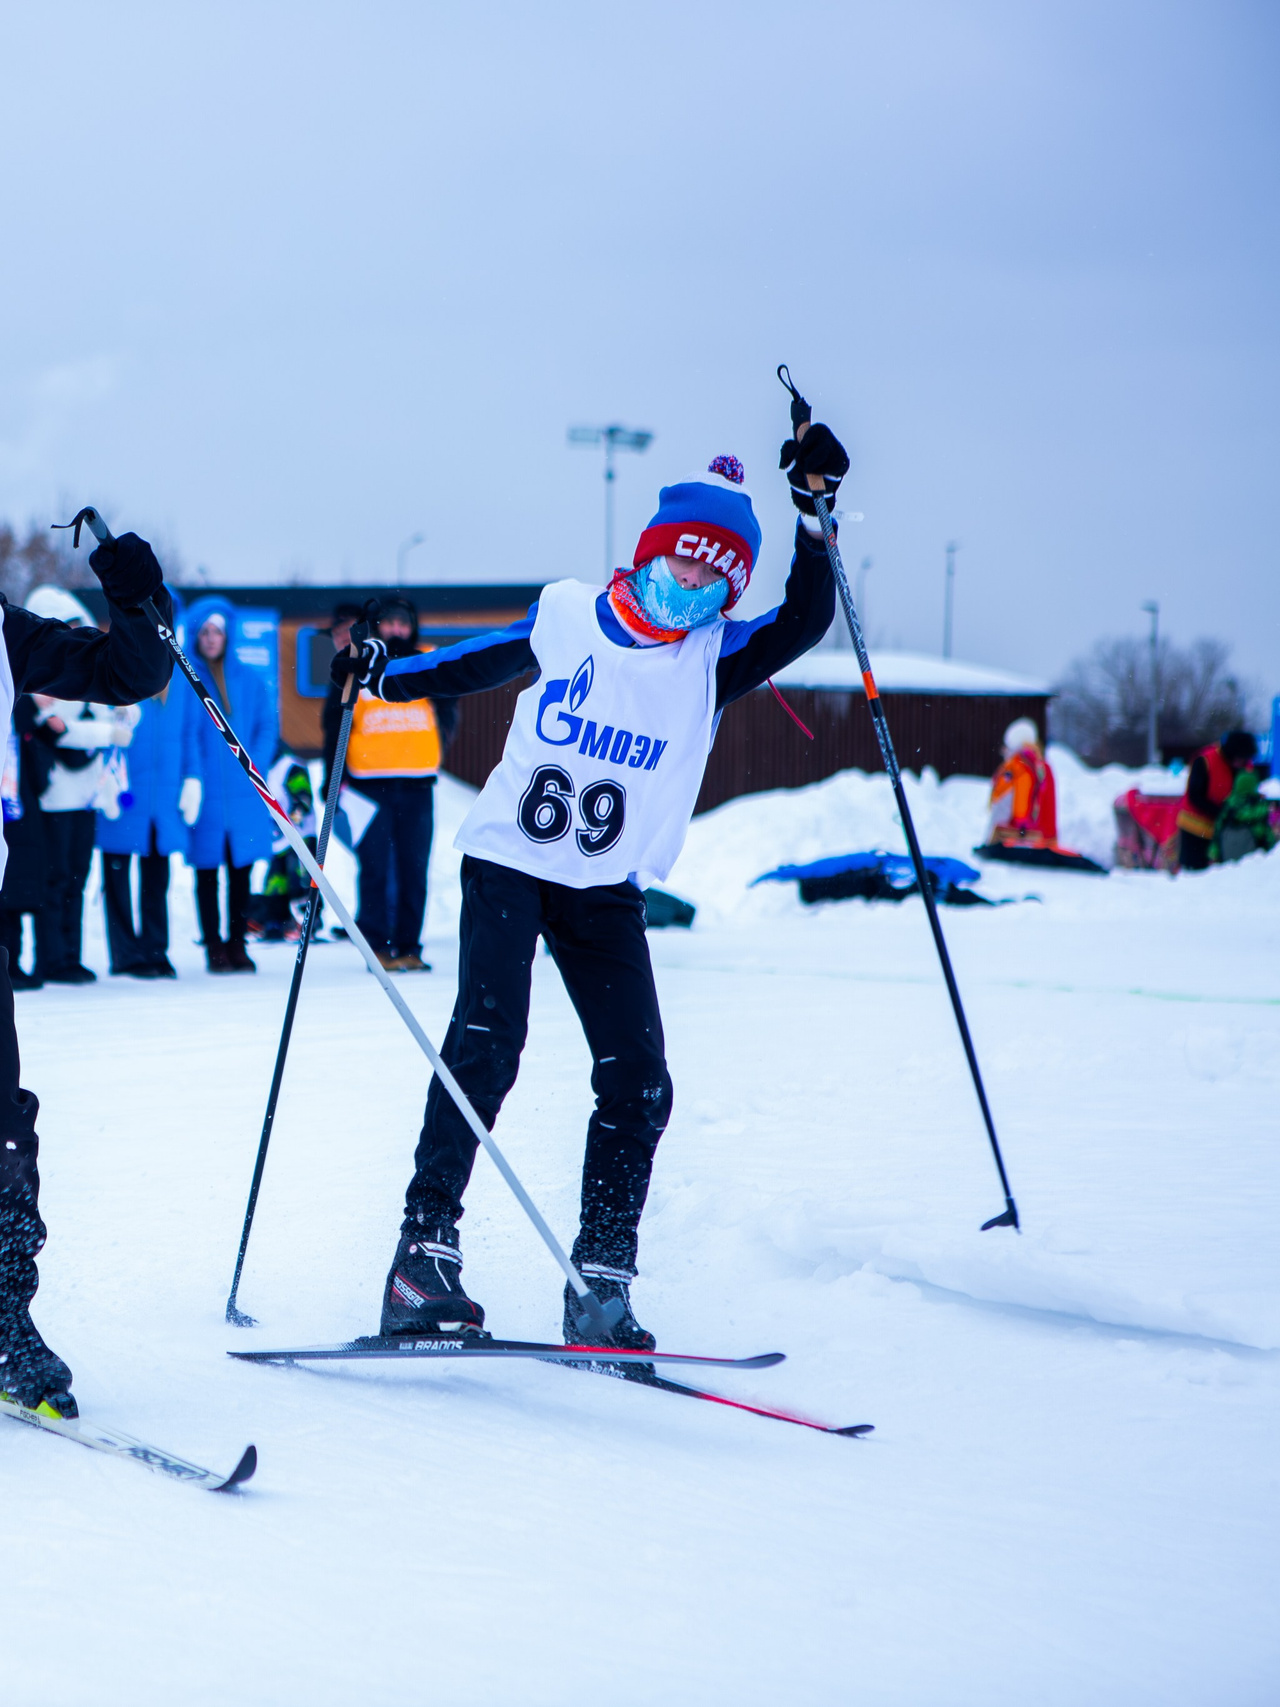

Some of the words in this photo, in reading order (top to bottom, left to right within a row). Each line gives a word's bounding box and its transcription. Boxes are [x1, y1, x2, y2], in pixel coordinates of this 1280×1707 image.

[169, 637, 200, 681] FISCHER
[517, 764, 626, 857] 69
[393, 1275, 426, 1309] ROSSIGNOL
